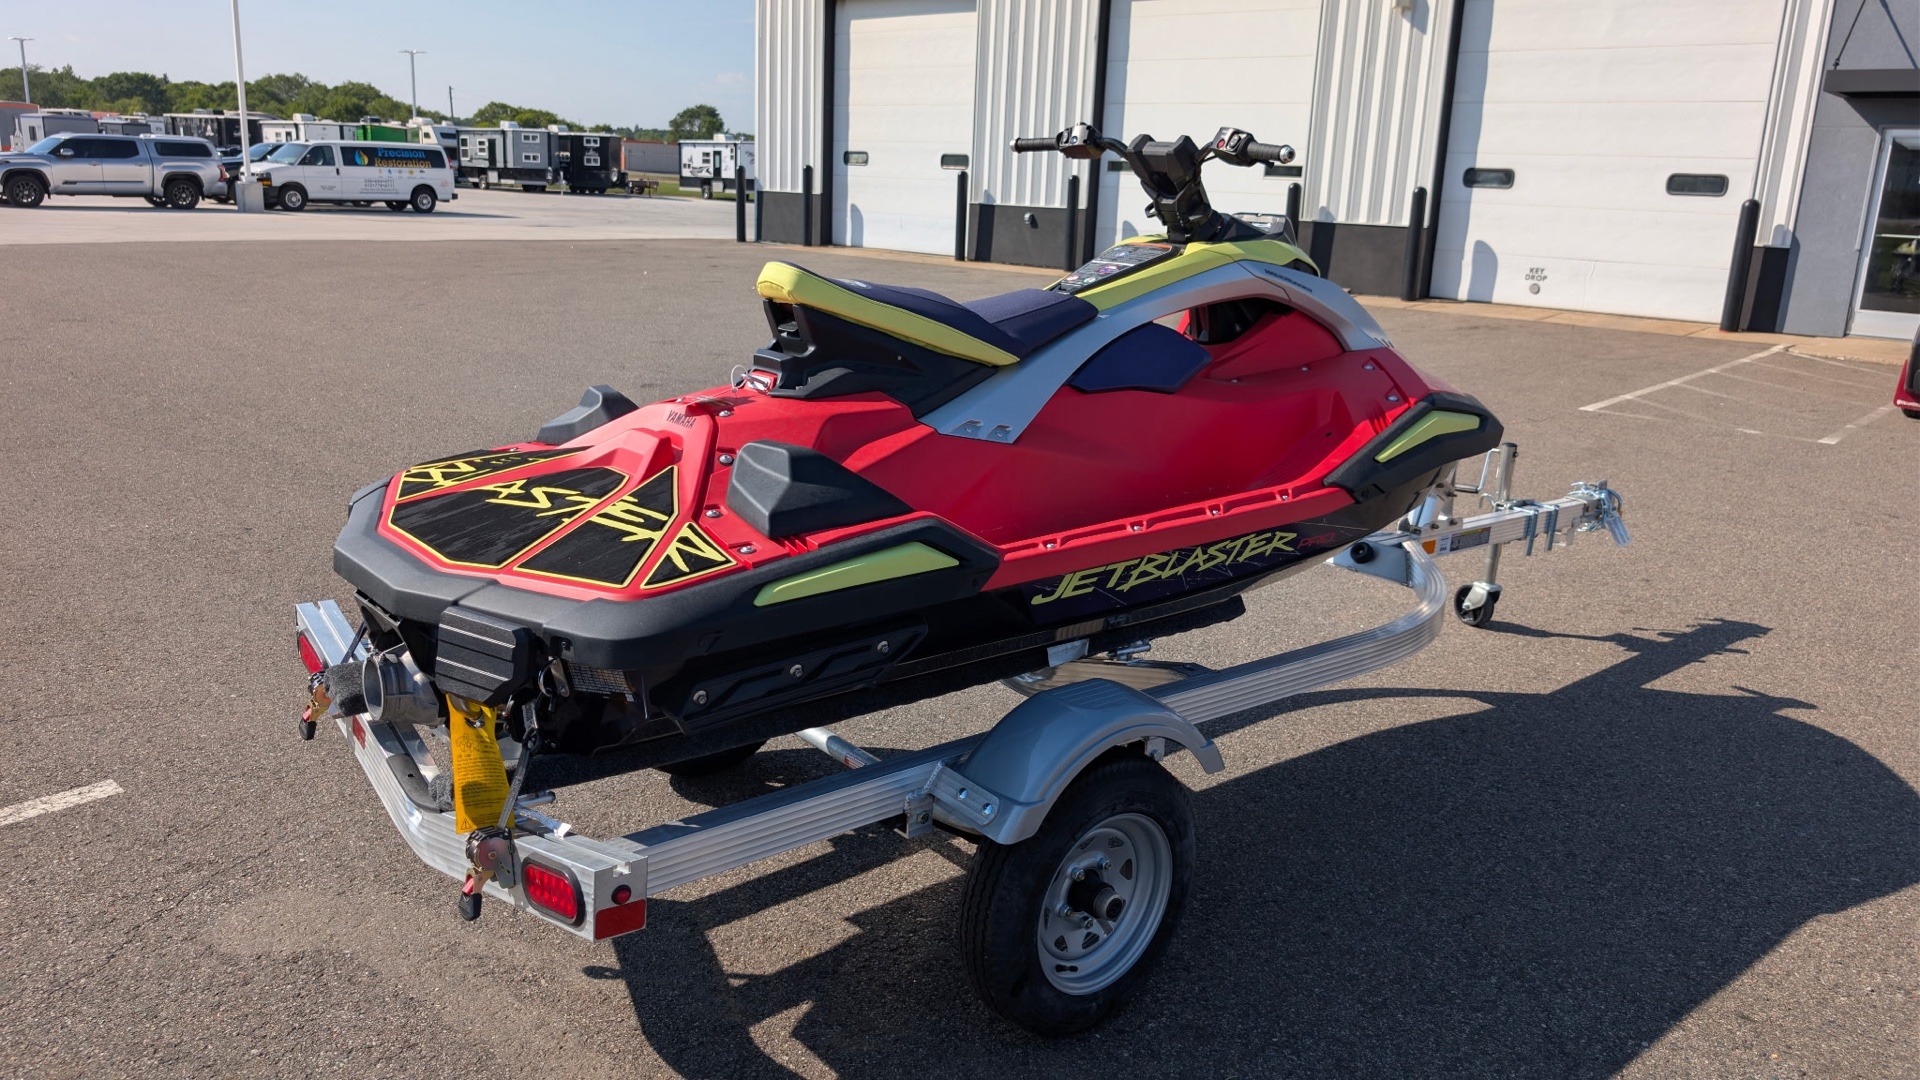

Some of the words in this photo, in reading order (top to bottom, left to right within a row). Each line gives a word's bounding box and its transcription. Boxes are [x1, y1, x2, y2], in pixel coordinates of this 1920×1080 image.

[377, 147, 425, 157] Precision
[374, 157, 432, 168] Restoration
[1525, 273, 1547, 281] DROP
[666, 410, 697, 429] YAMAHA
[1030, 530, 1298, 606] JETBLASTER
